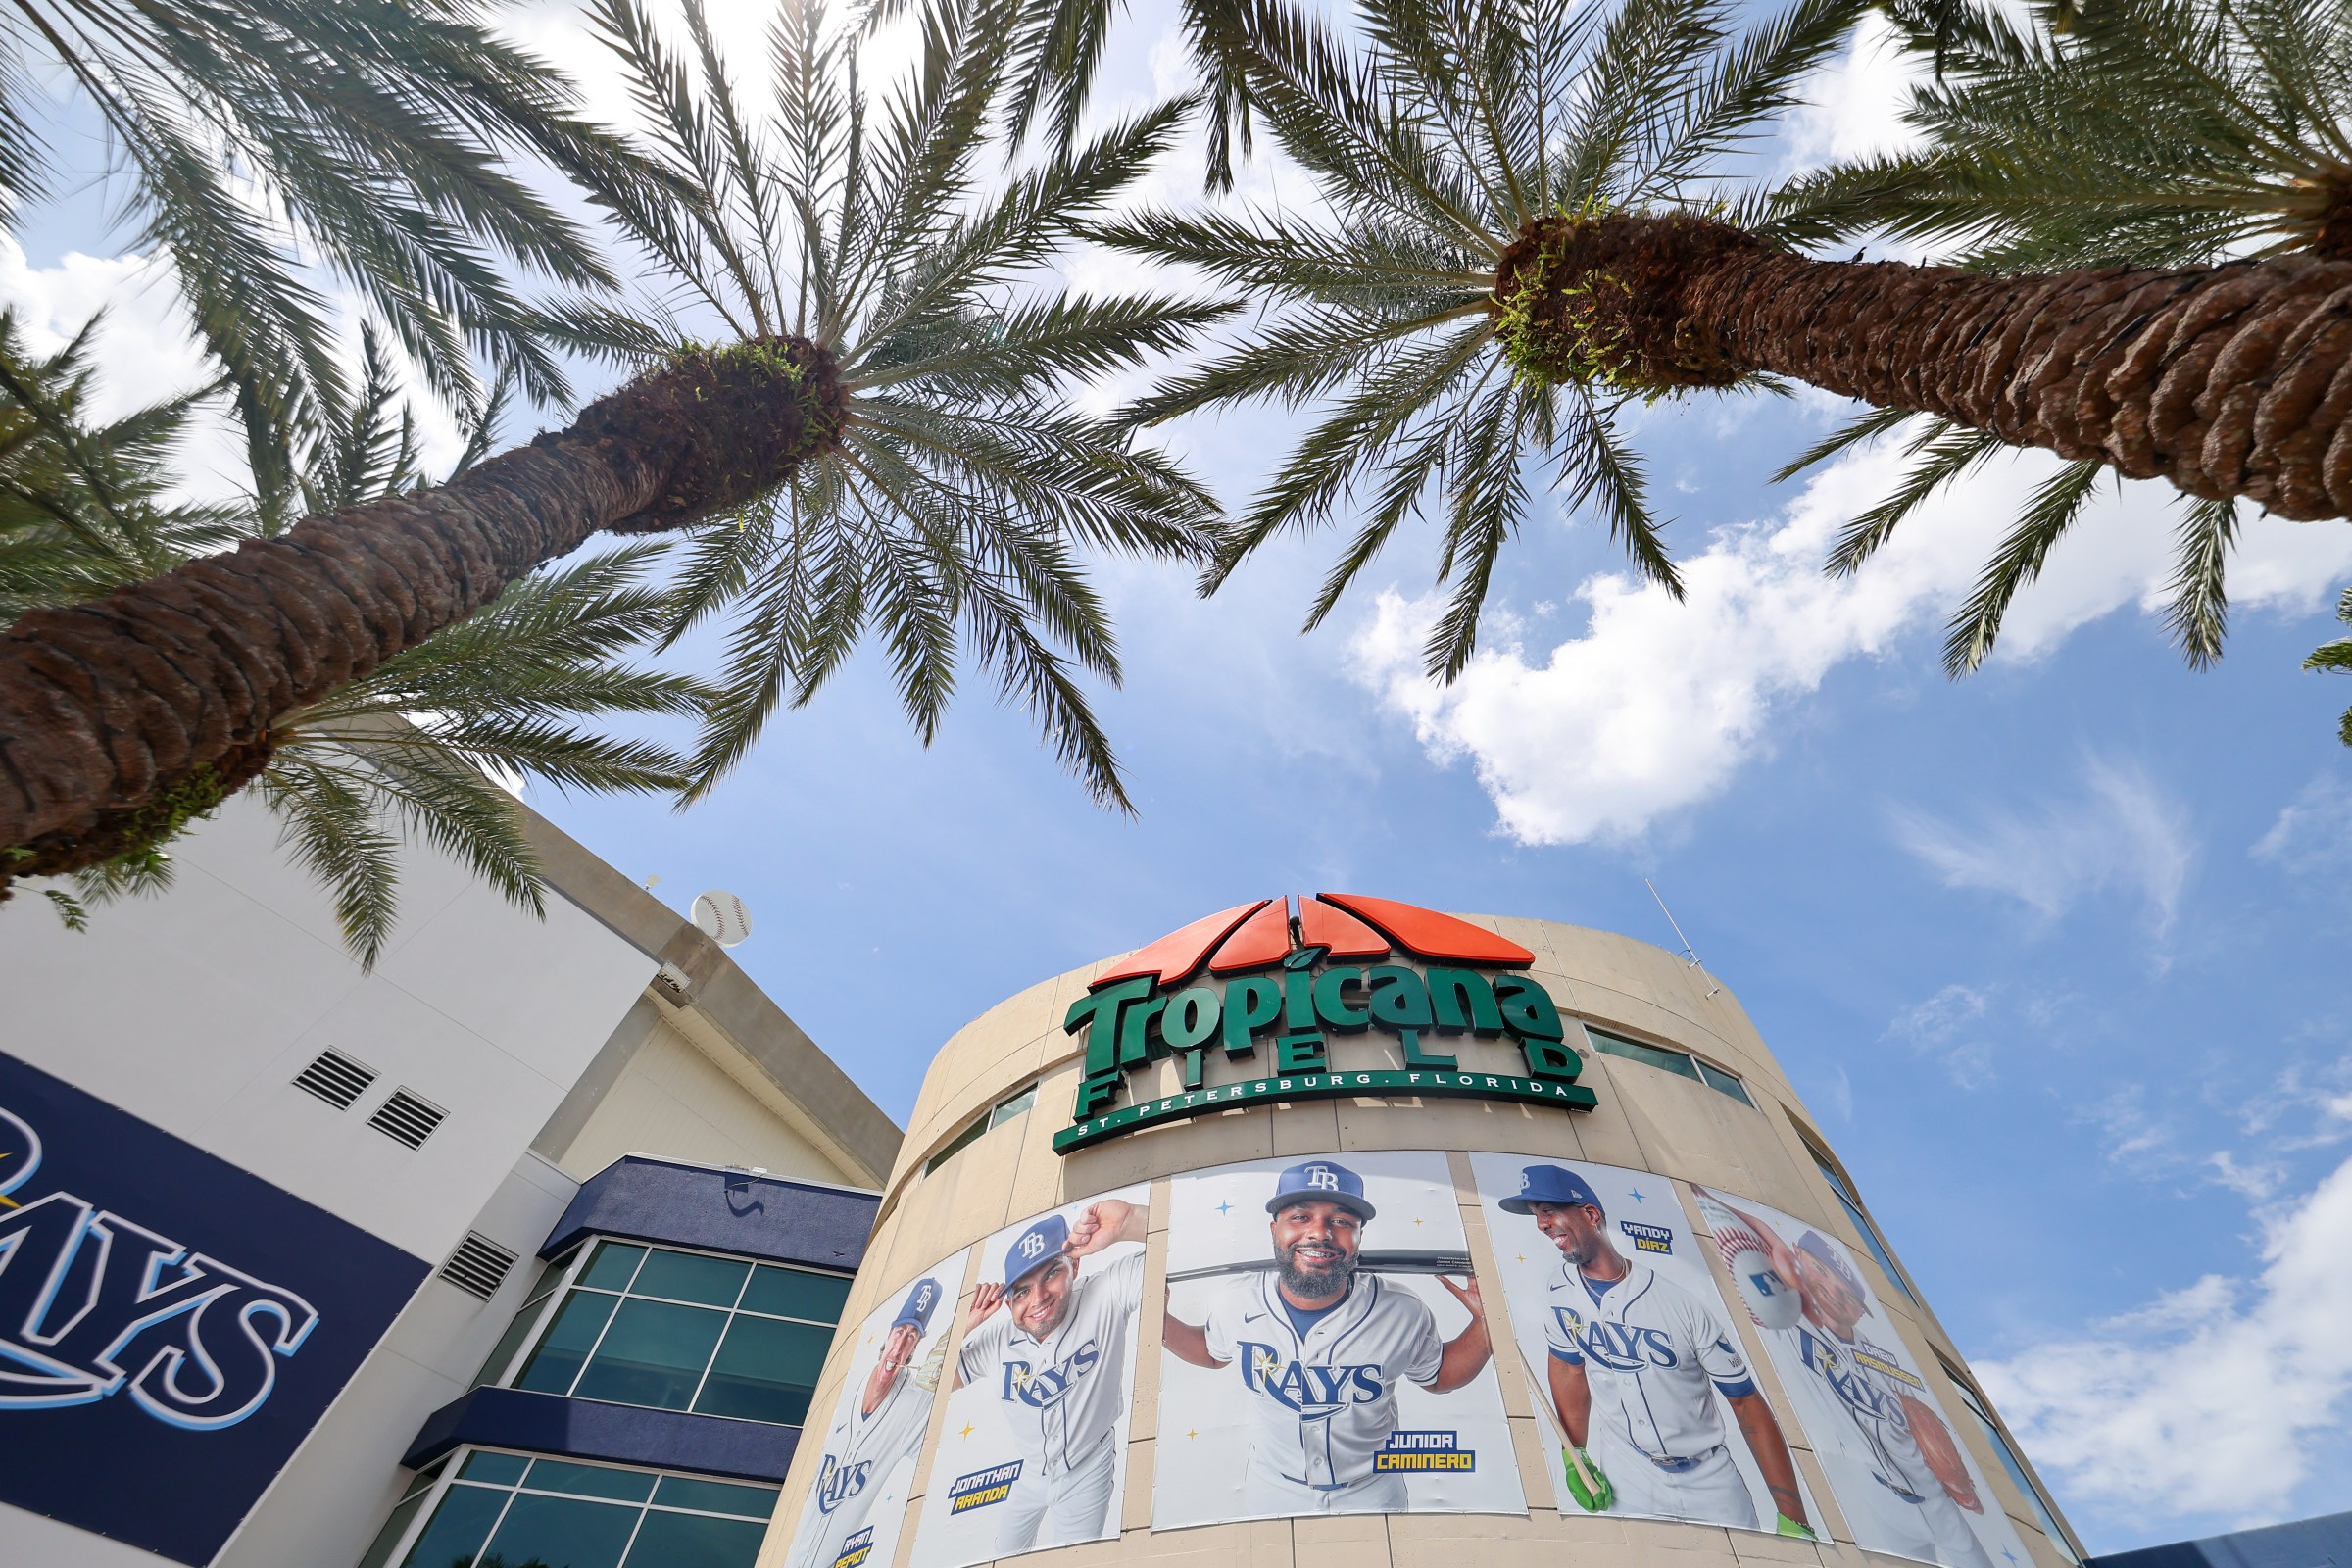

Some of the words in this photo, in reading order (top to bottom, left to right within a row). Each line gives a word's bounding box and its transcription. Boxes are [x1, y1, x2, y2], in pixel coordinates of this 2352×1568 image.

[1063, 956, 1564, 1077] Tropicana
[1074, 1029, 1584, 1123] FIELD
[1077, 1115, 1121, 1137] ST.
[1409, 1073, 1568, 1097] FLORIDA
[1018, 1231, 1046, 1260] TB
[1623, 1223, 1670, 1241] YANDY
[1637, 1237, 1670, 1253] DÍAZ
[1550, 1305, 1679, 1372] RAYS
[1863, 1343, 1897, 1366] DREW
[1001, 1337, 1099, 1412] RAYS
[1236, 1340, 1385, 1422] RAYS
[1796, 1326, 1907, 1428] RAYS
[1853, 1351, 1922, 1390] RASMUSSEN
[1389, 1434, 1453, 1449] JUNIOR
[951, 1463, 1021, 1495] JONATHAN
[1376, 1453, 1472, 1470] CAMINERO
[816, 1453, 873, 1516] RAYS
[954, 1484, 1010, 1511] ARANDA
[842, 1529, 872, 1554] RYAN
